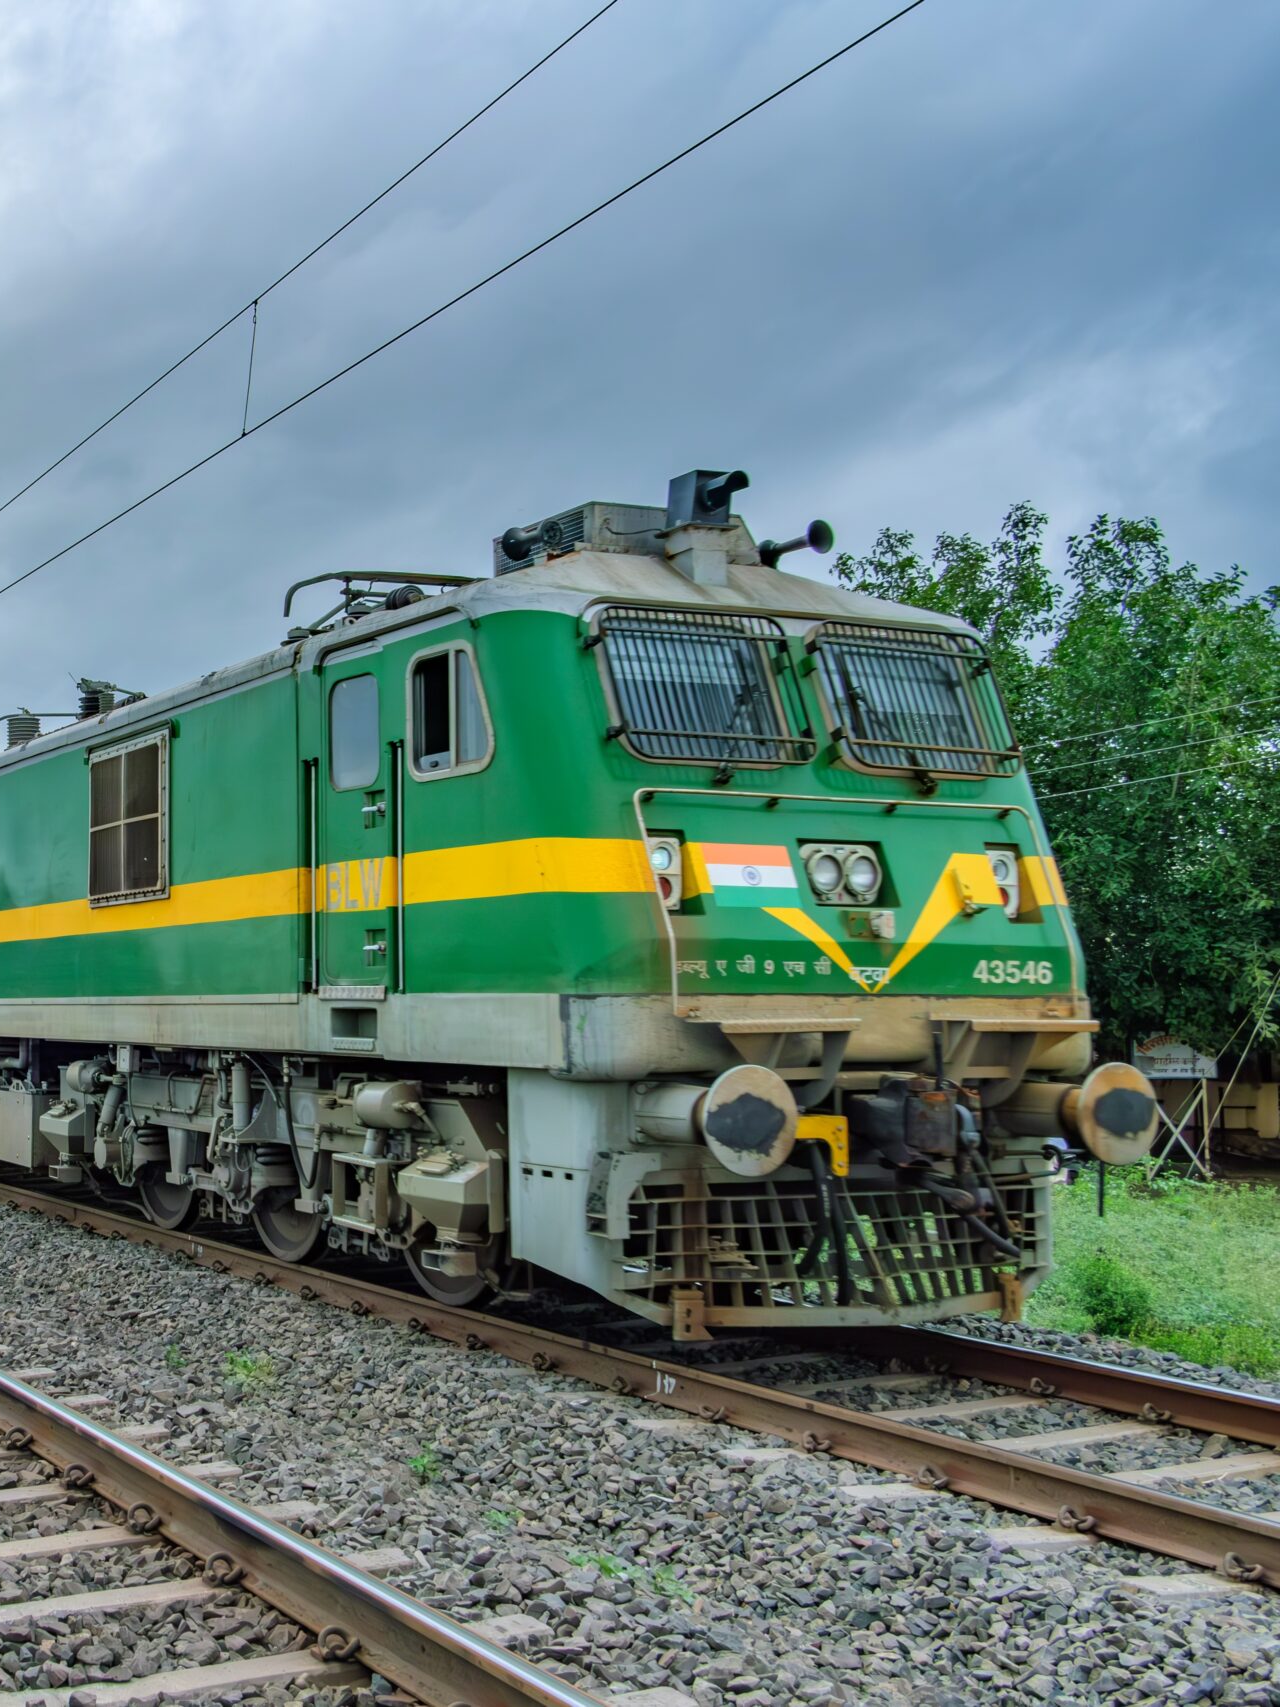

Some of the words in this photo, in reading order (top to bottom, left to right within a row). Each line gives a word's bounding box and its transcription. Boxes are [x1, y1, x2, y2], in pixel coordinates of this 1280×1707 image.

[326, 858, 383, 910] BLW
[736, 954, 756, 975] जी
[763, 959, 775, 975] 9
[972, 959, 1053, 985] 43546
